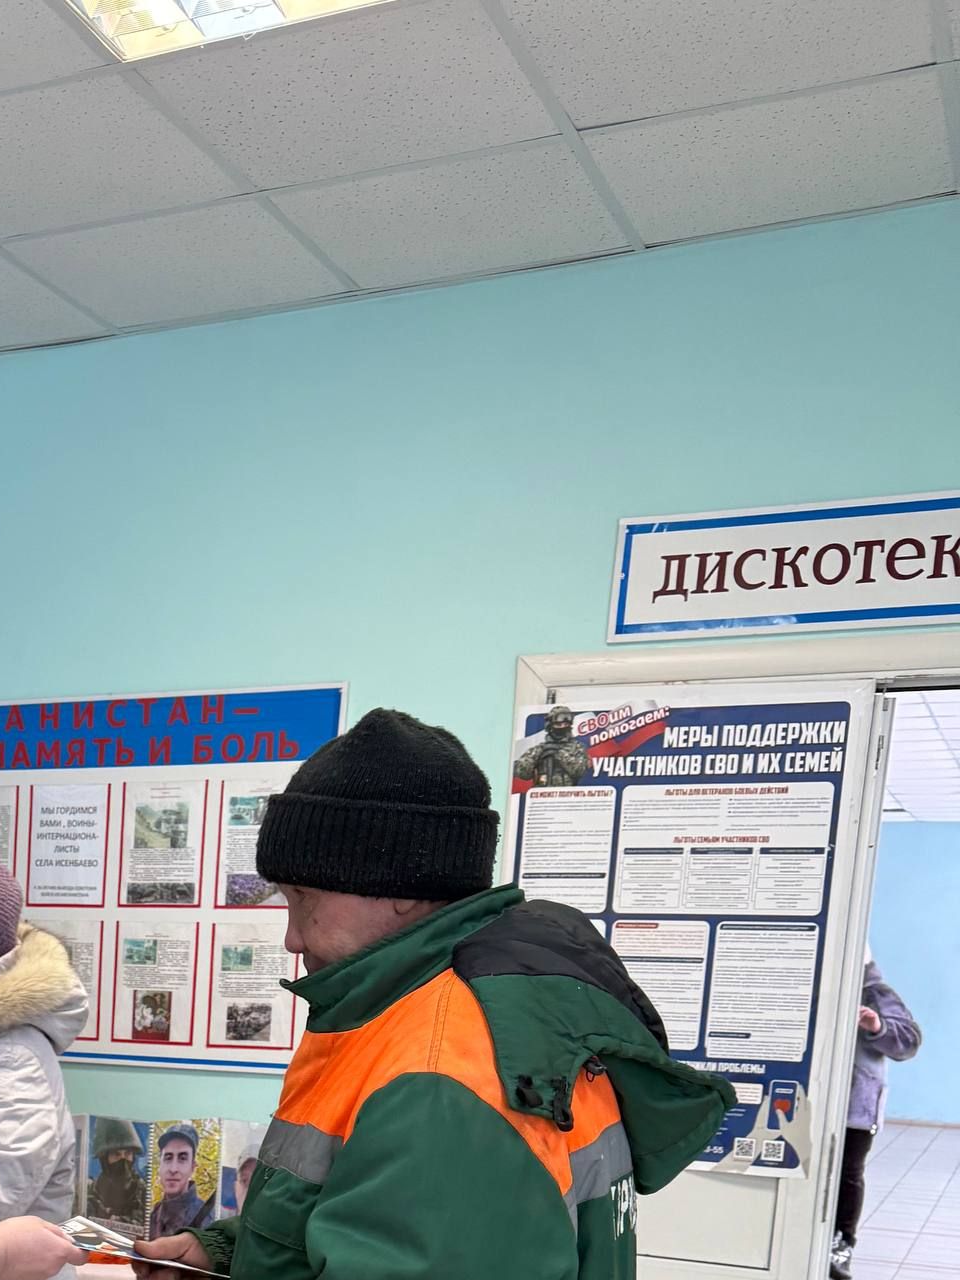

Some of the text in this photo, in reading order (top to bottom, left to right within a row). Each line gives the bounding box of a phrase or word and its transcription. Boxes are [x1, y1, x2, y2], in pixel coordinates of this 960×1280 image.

[590, 706, 670, 745] помогаем:
[663, 720, 847, 749] МЕРЫ ПОДДЕРЖКИ
[149, 735, 172, 765] И
[192, 731, 300, 764] БОЛЬ
[591, 746, 843, 777] УЧАСТНИКОВ СВО И ИХ СЕМЕЙ
[41, 806, 97, 816] МЫ ГОРДИМСЯ
[39, 819, 62, 828] ВАМИ
[54, 845, 80, 854] ЛИСТЫ
[35, 858, 54, 868] СЕЛА
